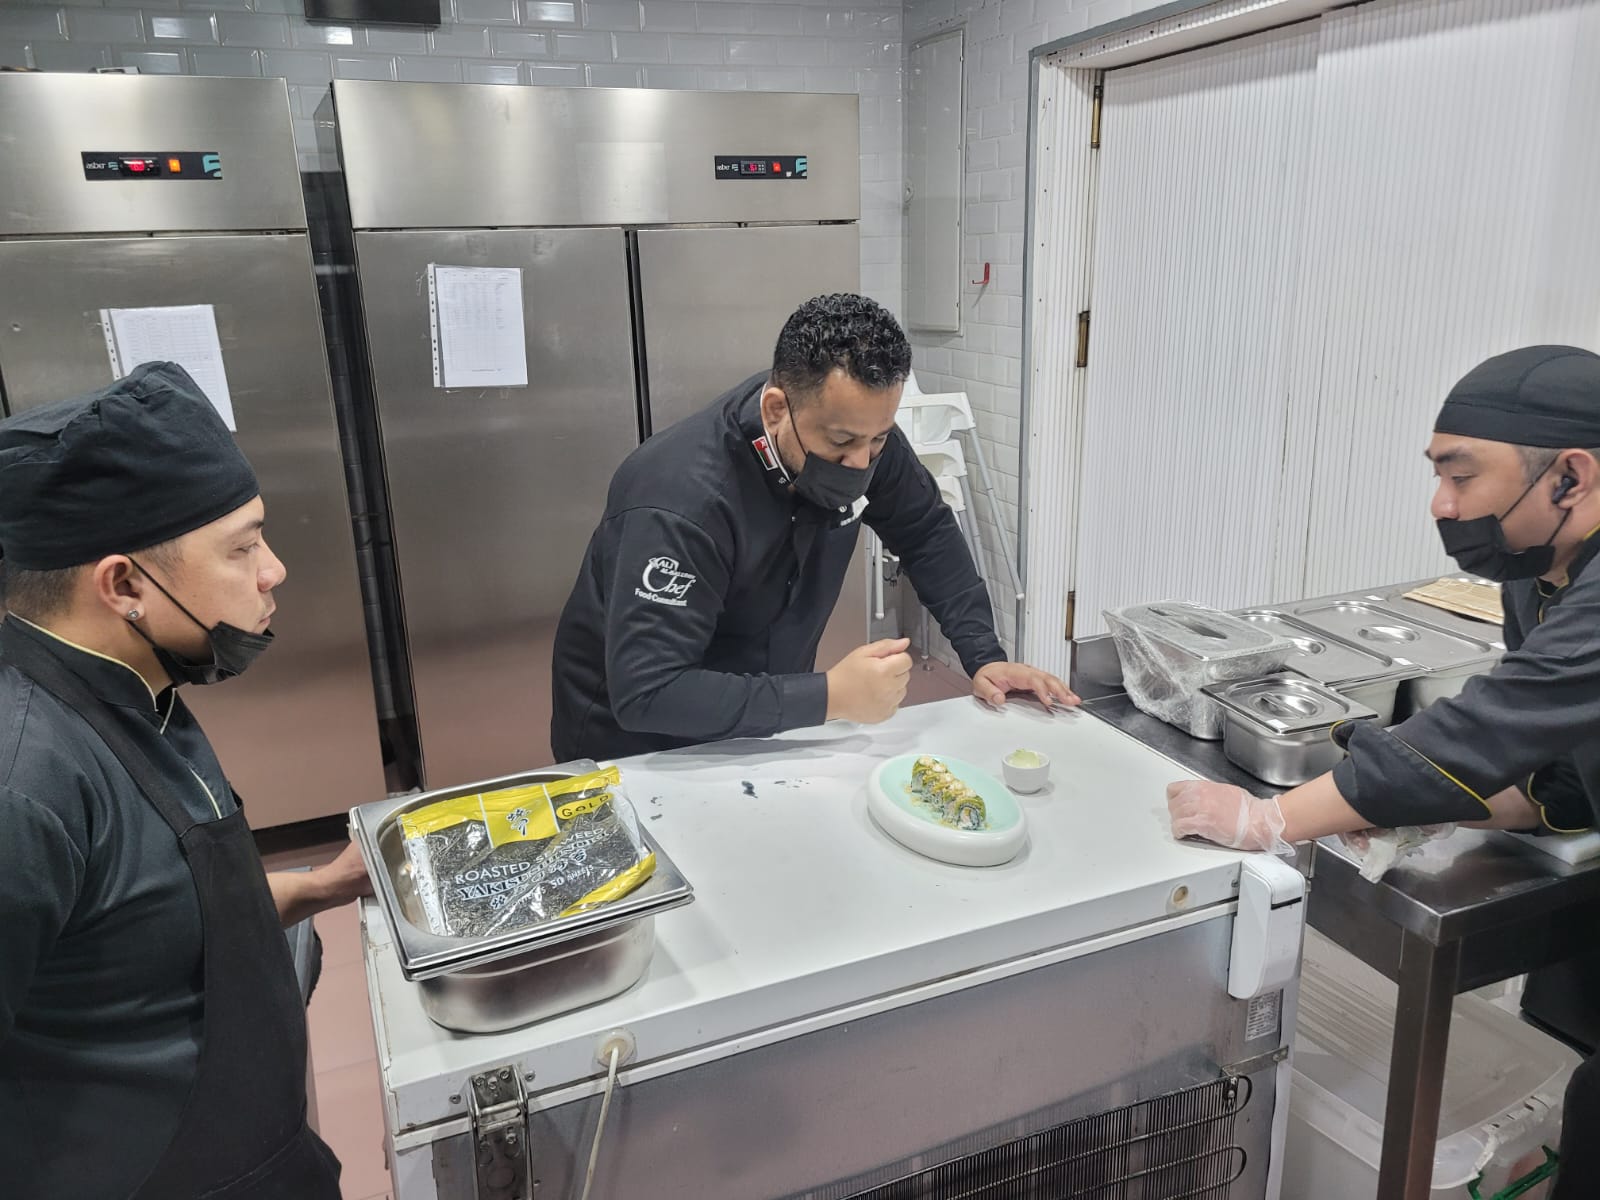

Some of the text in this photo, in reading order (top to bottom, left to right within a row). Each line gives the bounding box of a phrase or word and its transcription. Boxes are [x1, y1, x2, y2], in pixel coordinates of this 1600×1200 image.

[642, 556, 697, 600] Chef
[561, 795, 609, 818] GOLD
[455, 861, 531, 885] ROASTED
[550, 876, 565, 889] 50
